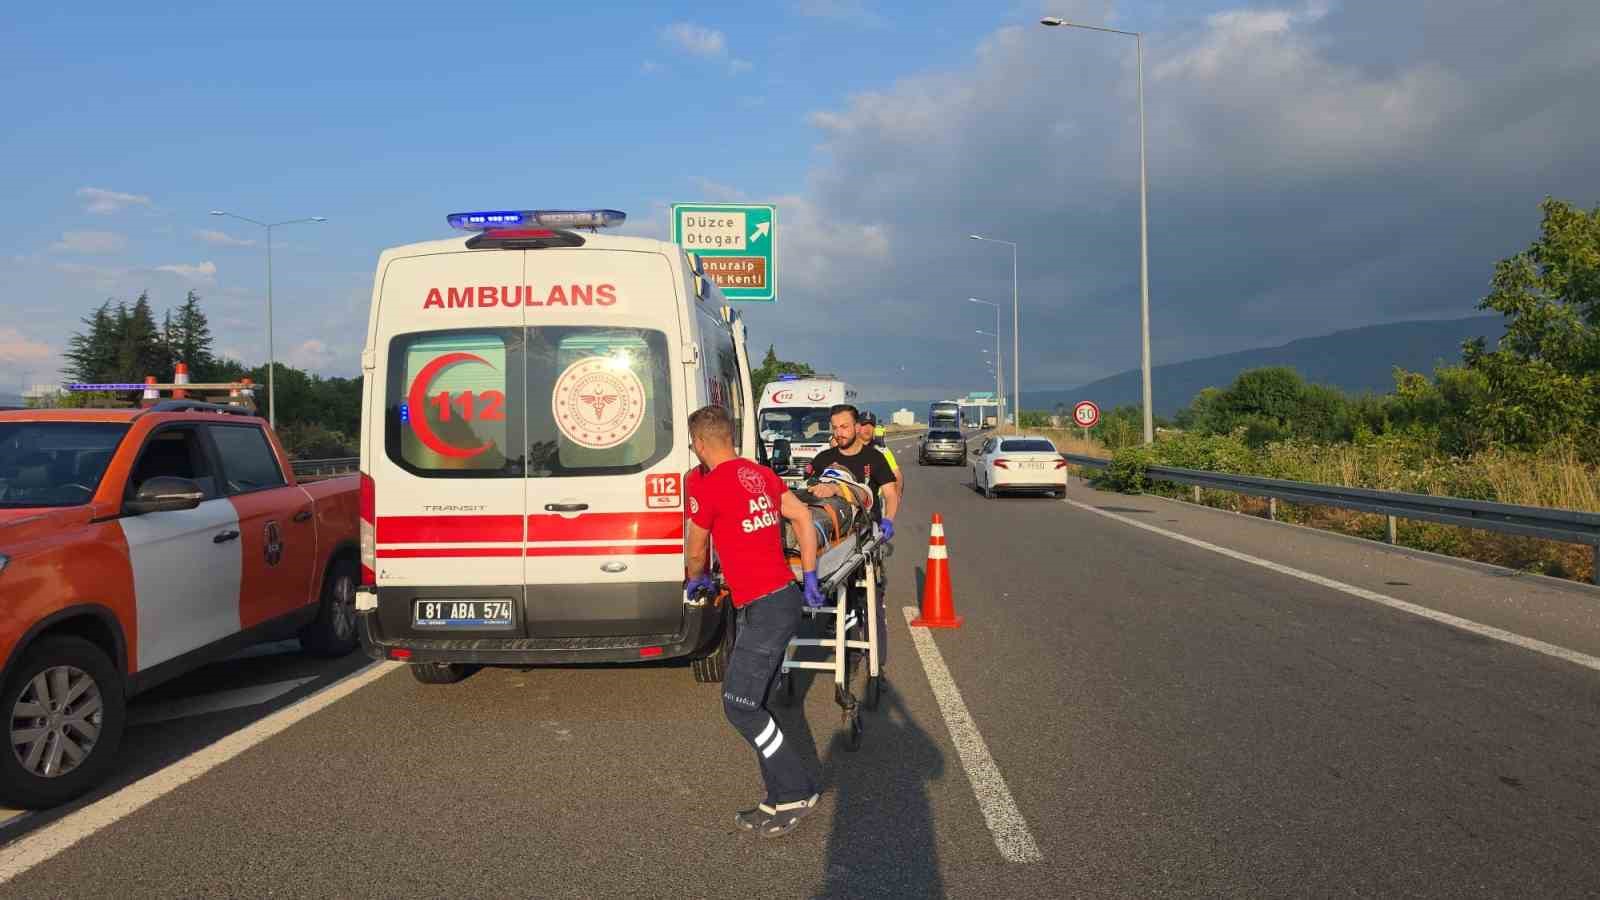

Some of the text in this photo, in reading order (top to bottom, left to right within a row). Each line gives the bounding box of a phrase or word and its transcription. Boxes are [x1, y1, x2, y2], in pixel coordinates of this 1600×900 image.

[686, 216, 735, 228] Düzce
[686, 233, 741, 247] Otogar
[423, 283, 617, 310] AMBULANS
[430, 389, 506, 422] 112
[1079, 408, 1095, 420] 50
[651, 477, 677, 494] 112
[425, 602, 510, 620] 81 ABA 574
